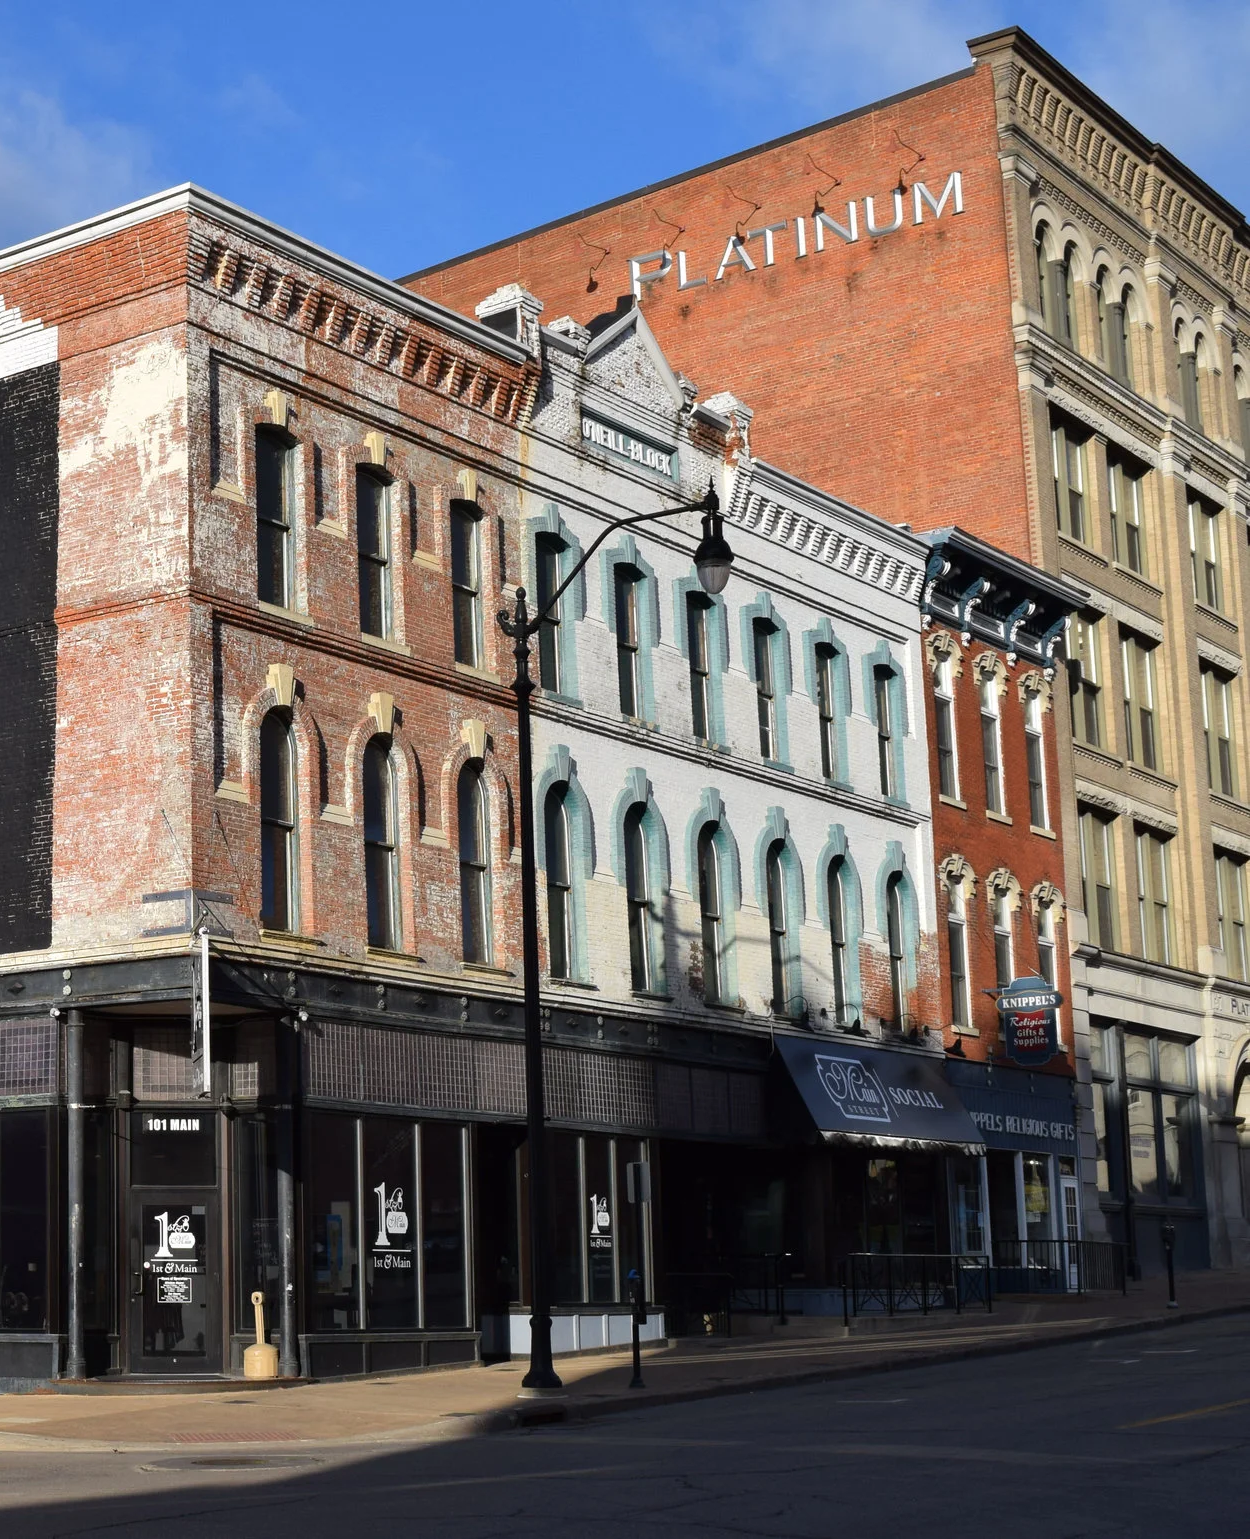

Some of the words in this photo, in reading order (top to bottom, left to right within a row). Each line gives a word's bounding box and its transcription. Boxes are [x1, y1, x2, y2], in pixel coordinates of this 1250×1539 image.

[628, 171, 965, 301] PLATINUM
[1002, 994, 1056, 1009] KNIPPEL'S
[1010, 1016, 1051, 1028] Religious
[1017, 1028, 1036, 1037] Gifts
[1038, 1027, 1045, 1036] &
[1013, 1036, 1050, 1047] Supplies
[825, 1062, 880, 1104] Main
[888, 1086, 944, 1109] SOCIAL
[847, 1104, 880, 1117] STREET
[147, 1118, 167, 1131] 101
[170, 1118, 200, 1131] MAIN
[1005, 1115, 1049, 1137] RELIGIOUS
[1050, 1121, 1075, 1141] GIFTS
[152, 1264, 164, 1273] 1st
[164, 1262, 175, 1274] &
[174, 1264, 198, 1273] Main
[374, 1256, 383, 1268] 1st
[384, 1254, 392, 1269] &
[392, 1256, 411, 1268] Main
